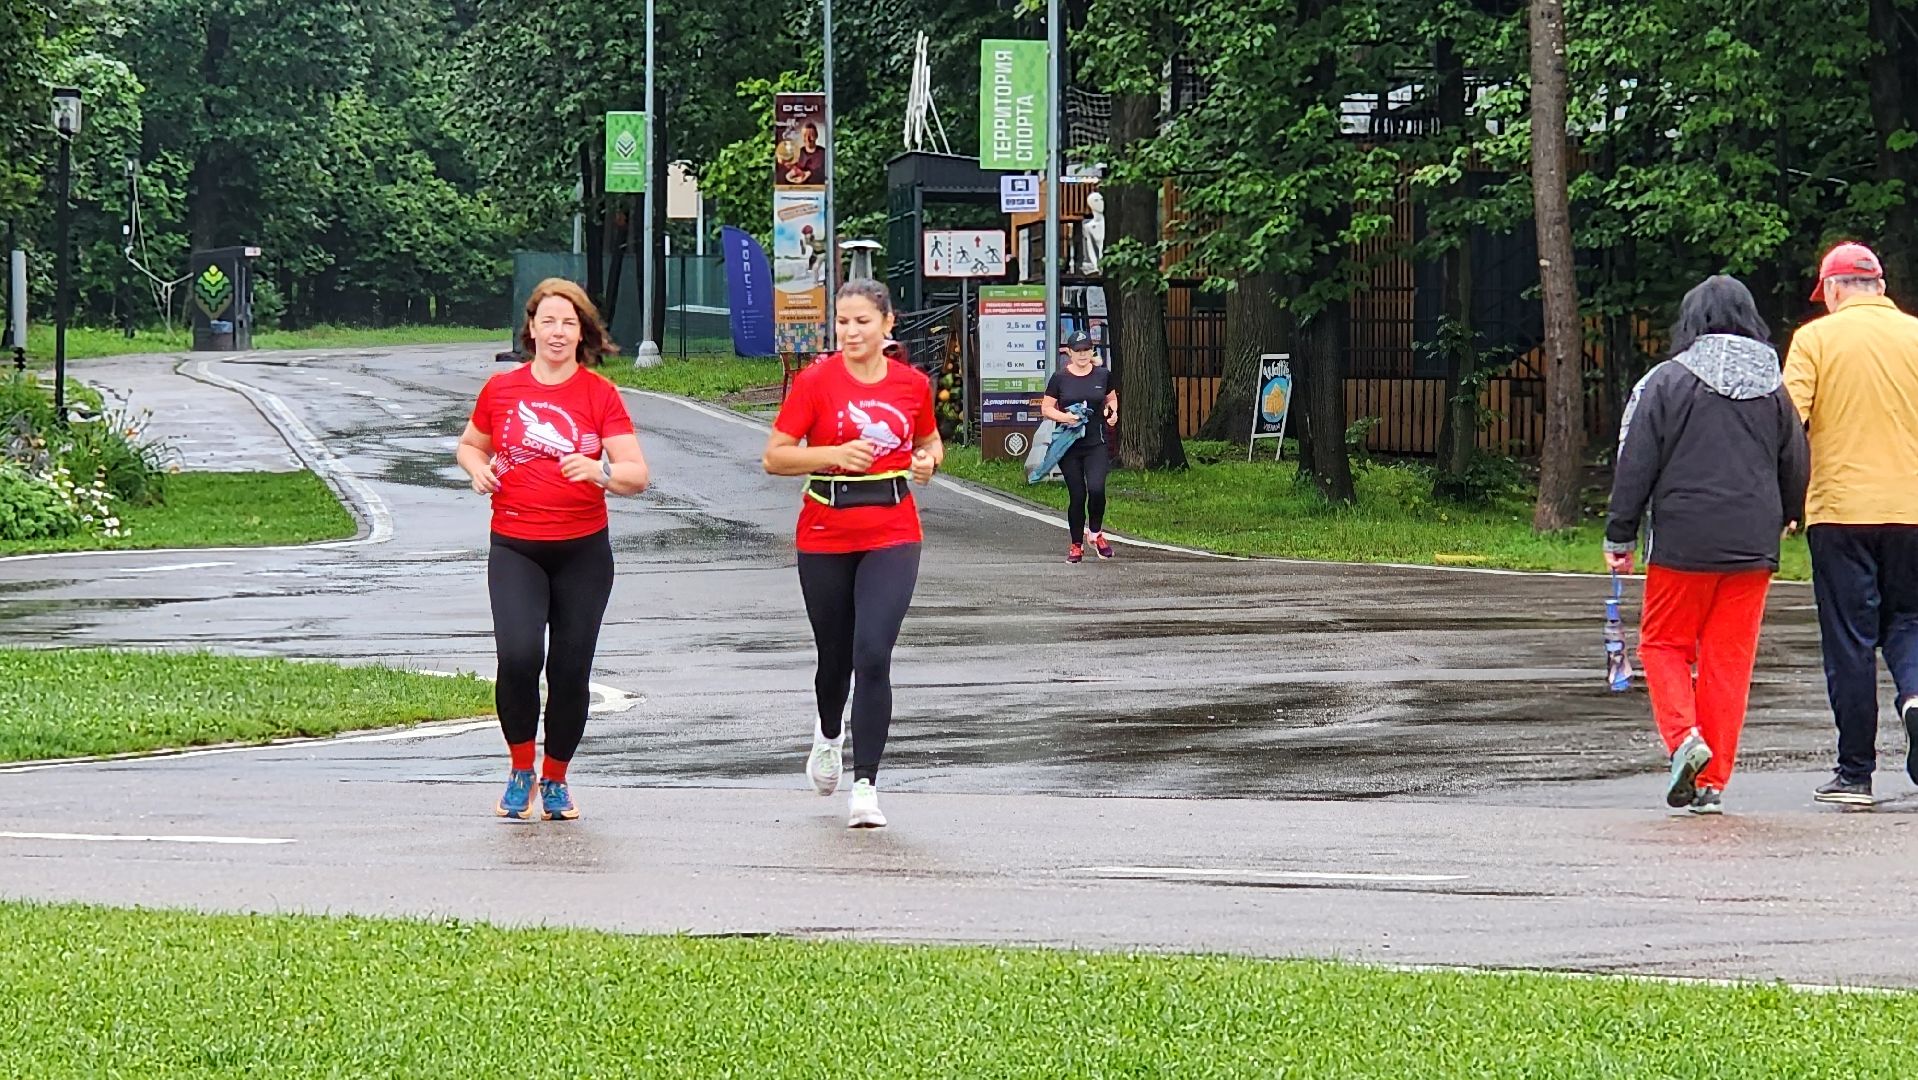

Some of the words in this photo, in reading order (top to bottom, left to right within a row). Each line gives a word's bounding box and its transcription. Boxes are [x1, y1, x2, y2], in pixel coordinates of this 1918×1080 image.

[994, 50, 1012, 161] ТЕРРИТОРИЯ
[1016, 94, 1034, 161] СПОРТА
[521, 437, 543, 451] ODI
